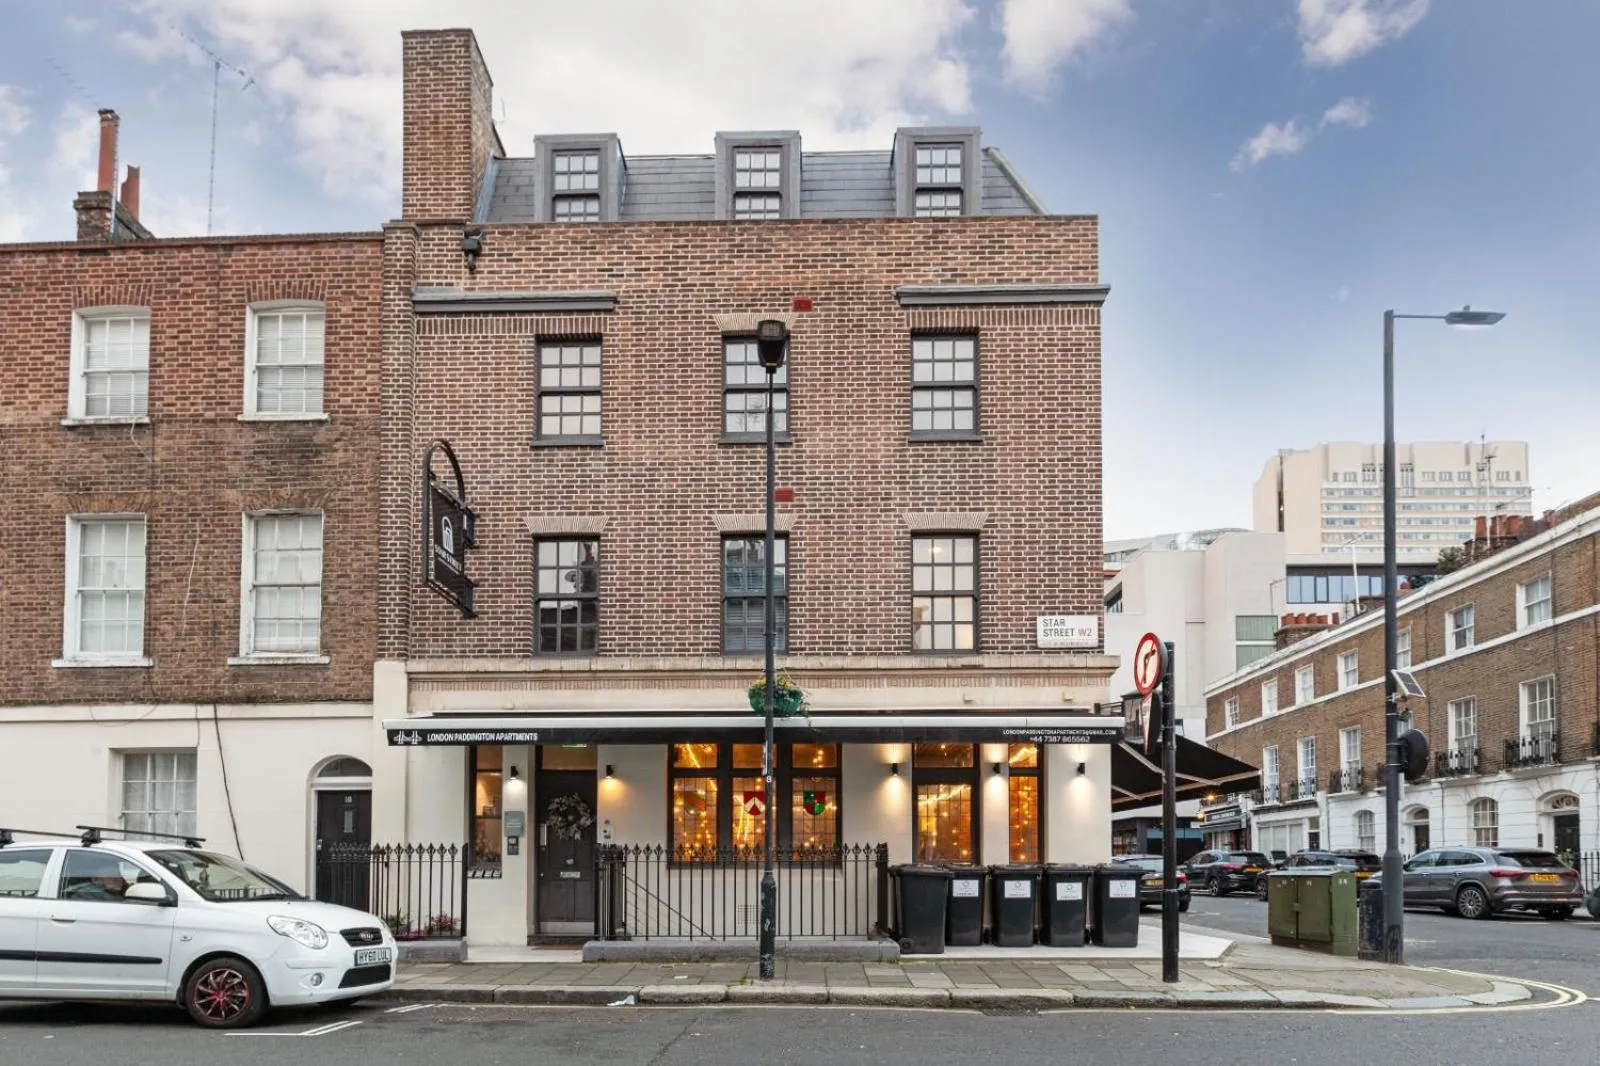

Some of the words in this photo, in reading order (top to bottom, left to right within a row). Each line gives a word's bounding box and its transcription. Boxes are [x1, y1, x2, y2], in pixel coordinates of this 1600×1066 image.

[1042, 618, 1066, 628] STAR
[1042, 628, 1075, 638] STREET
[1078, 628, 1093, 637] W2
[427, 732, 454, 742] LONDON
[454, 732, 496, 742] PADDINGTON
[495, 732, 538, 742] APARTMENTS
